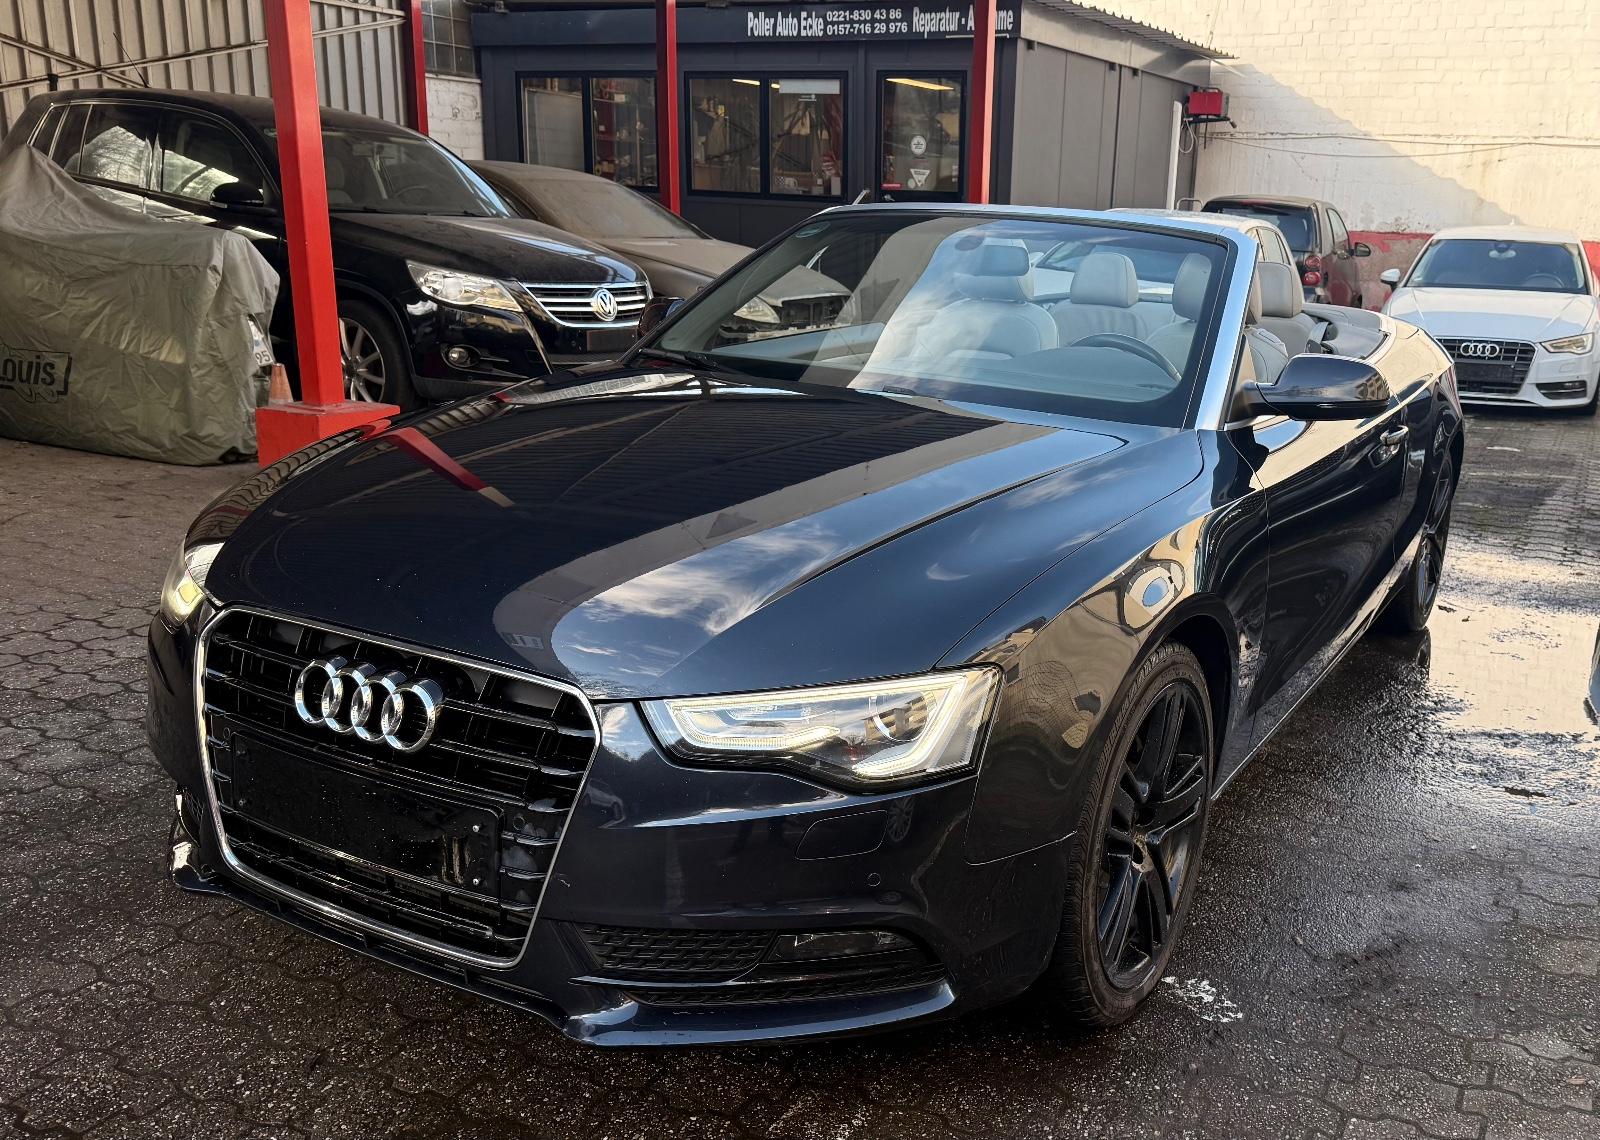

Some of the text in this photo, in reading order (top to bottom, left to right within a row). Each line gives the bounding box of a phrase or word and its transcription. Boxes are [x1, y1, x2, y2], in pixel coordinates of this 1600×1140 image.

[747, 11, 824, 36] Poller Auto Ecke
[826, 8, 902, 22] 0221-830 43 86
[912, 6, 960, 39] Reparatur
[826, 22, 908, 35] 0157-716 29 976
[0, 354, 56, 386] ouis
